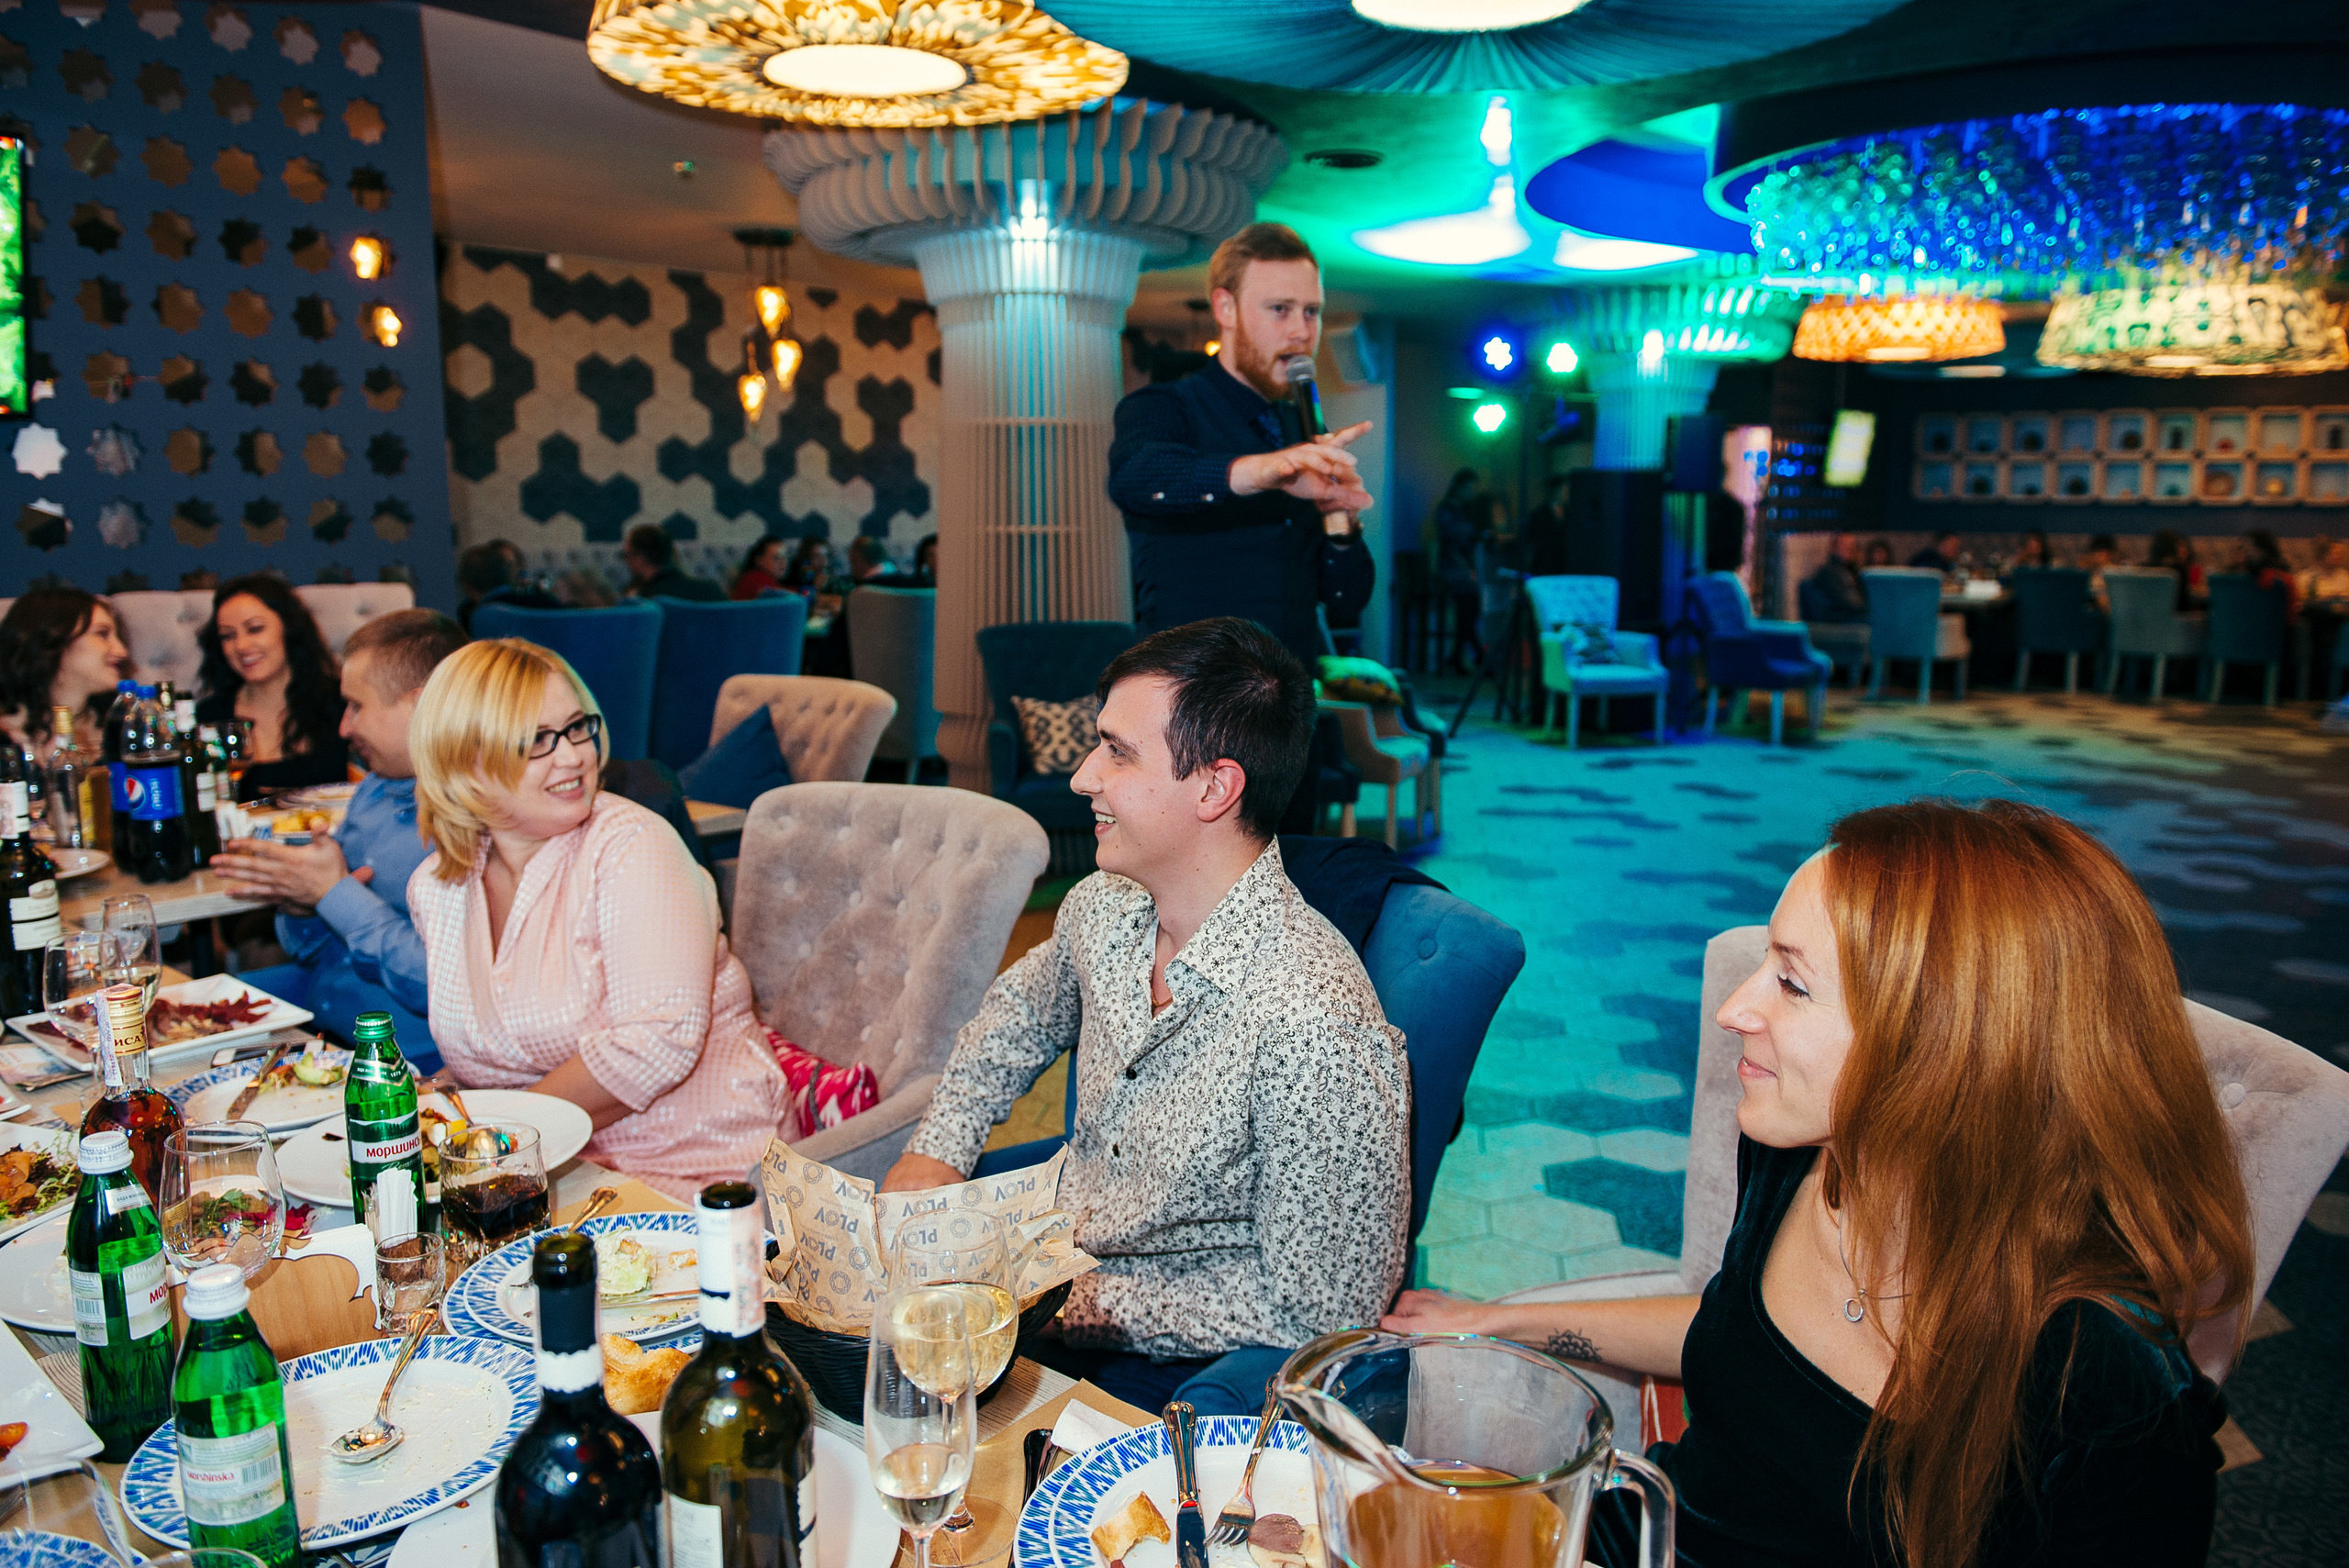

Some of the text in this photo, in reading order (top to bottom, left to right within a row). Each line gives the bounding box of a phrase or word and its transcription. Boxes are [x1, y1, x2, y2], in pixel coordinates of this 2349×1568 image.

[114, 1035, 141, 1047] ИСА
[995, 1177, 1035, 1202] PLOV
[902, 1197, 948, 1218] PLOV
[814, 1207, 859, 1234] PLOV
[800, 1232, 836, 1262] PLOV
[890, 1229, 938, 1251] PLOV
